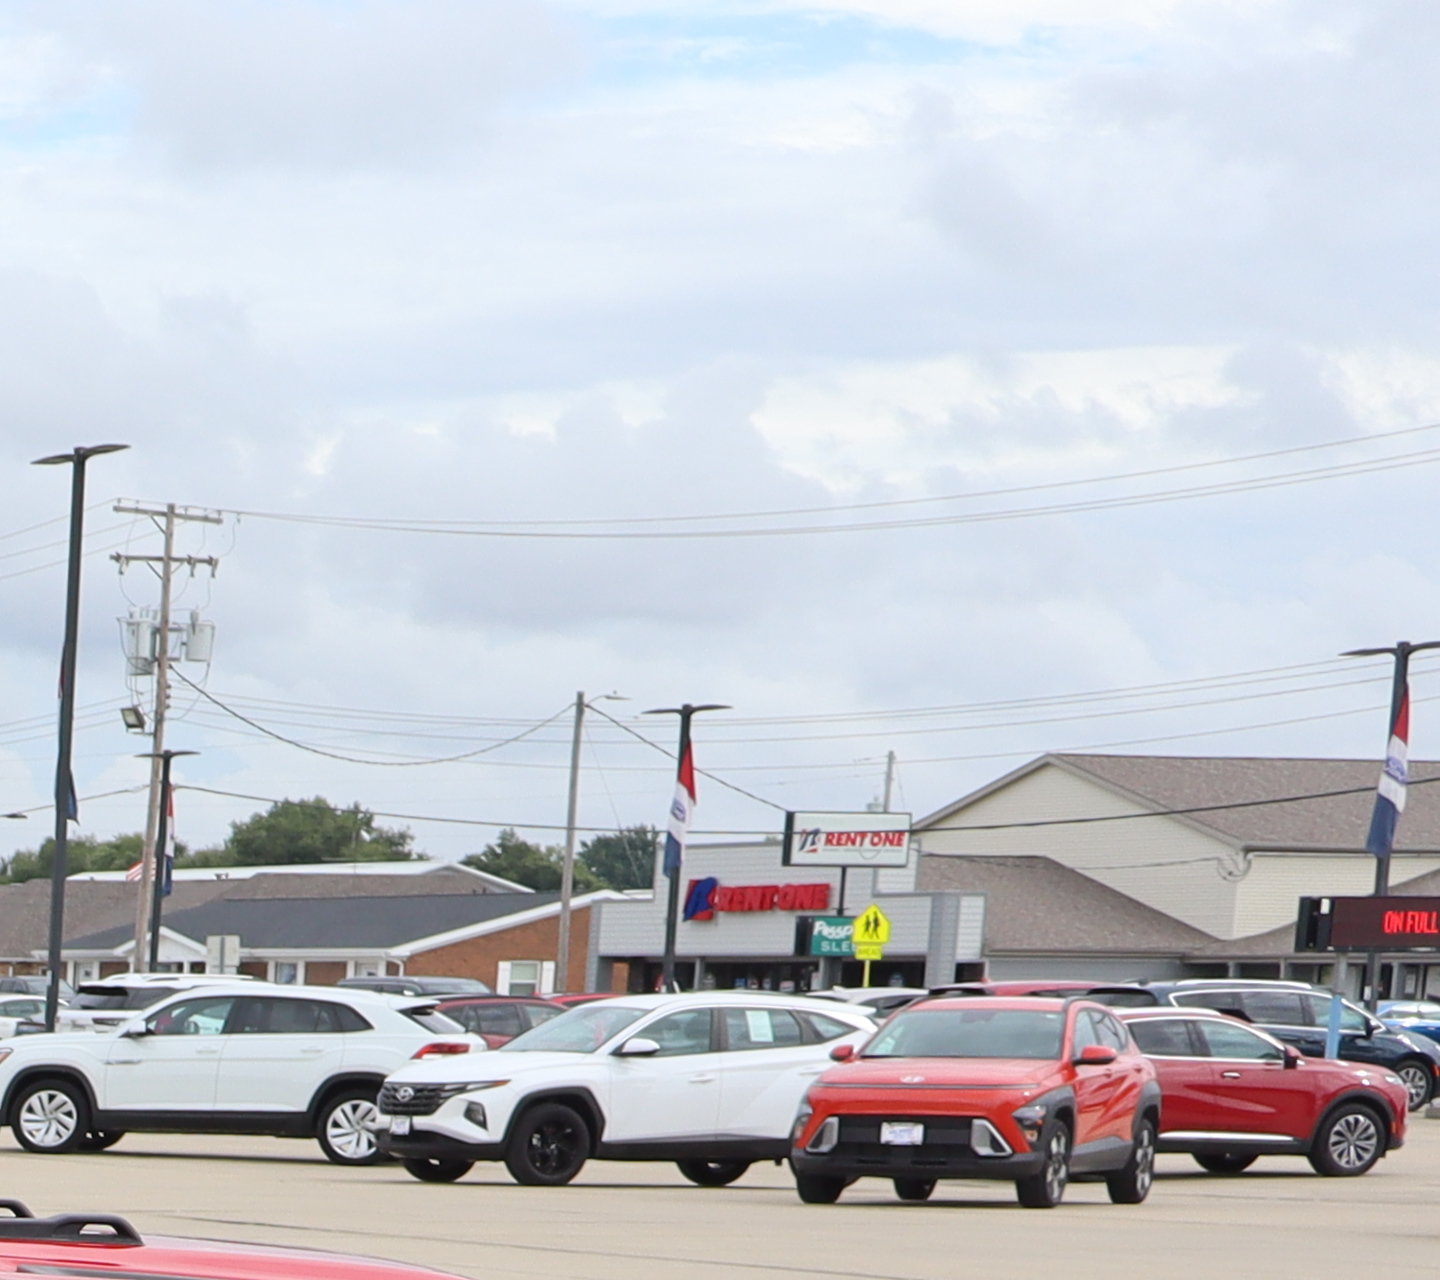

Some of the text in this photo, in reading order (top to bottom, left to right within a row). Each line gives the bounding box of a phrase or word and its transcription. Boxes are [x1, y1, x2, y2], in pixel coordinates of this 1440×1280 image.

[824, 830, 906, 847] RENT ONE
[716, 884, 831, 911] RENT ONE
[1384, 911, 1439, 933] ON FULL
